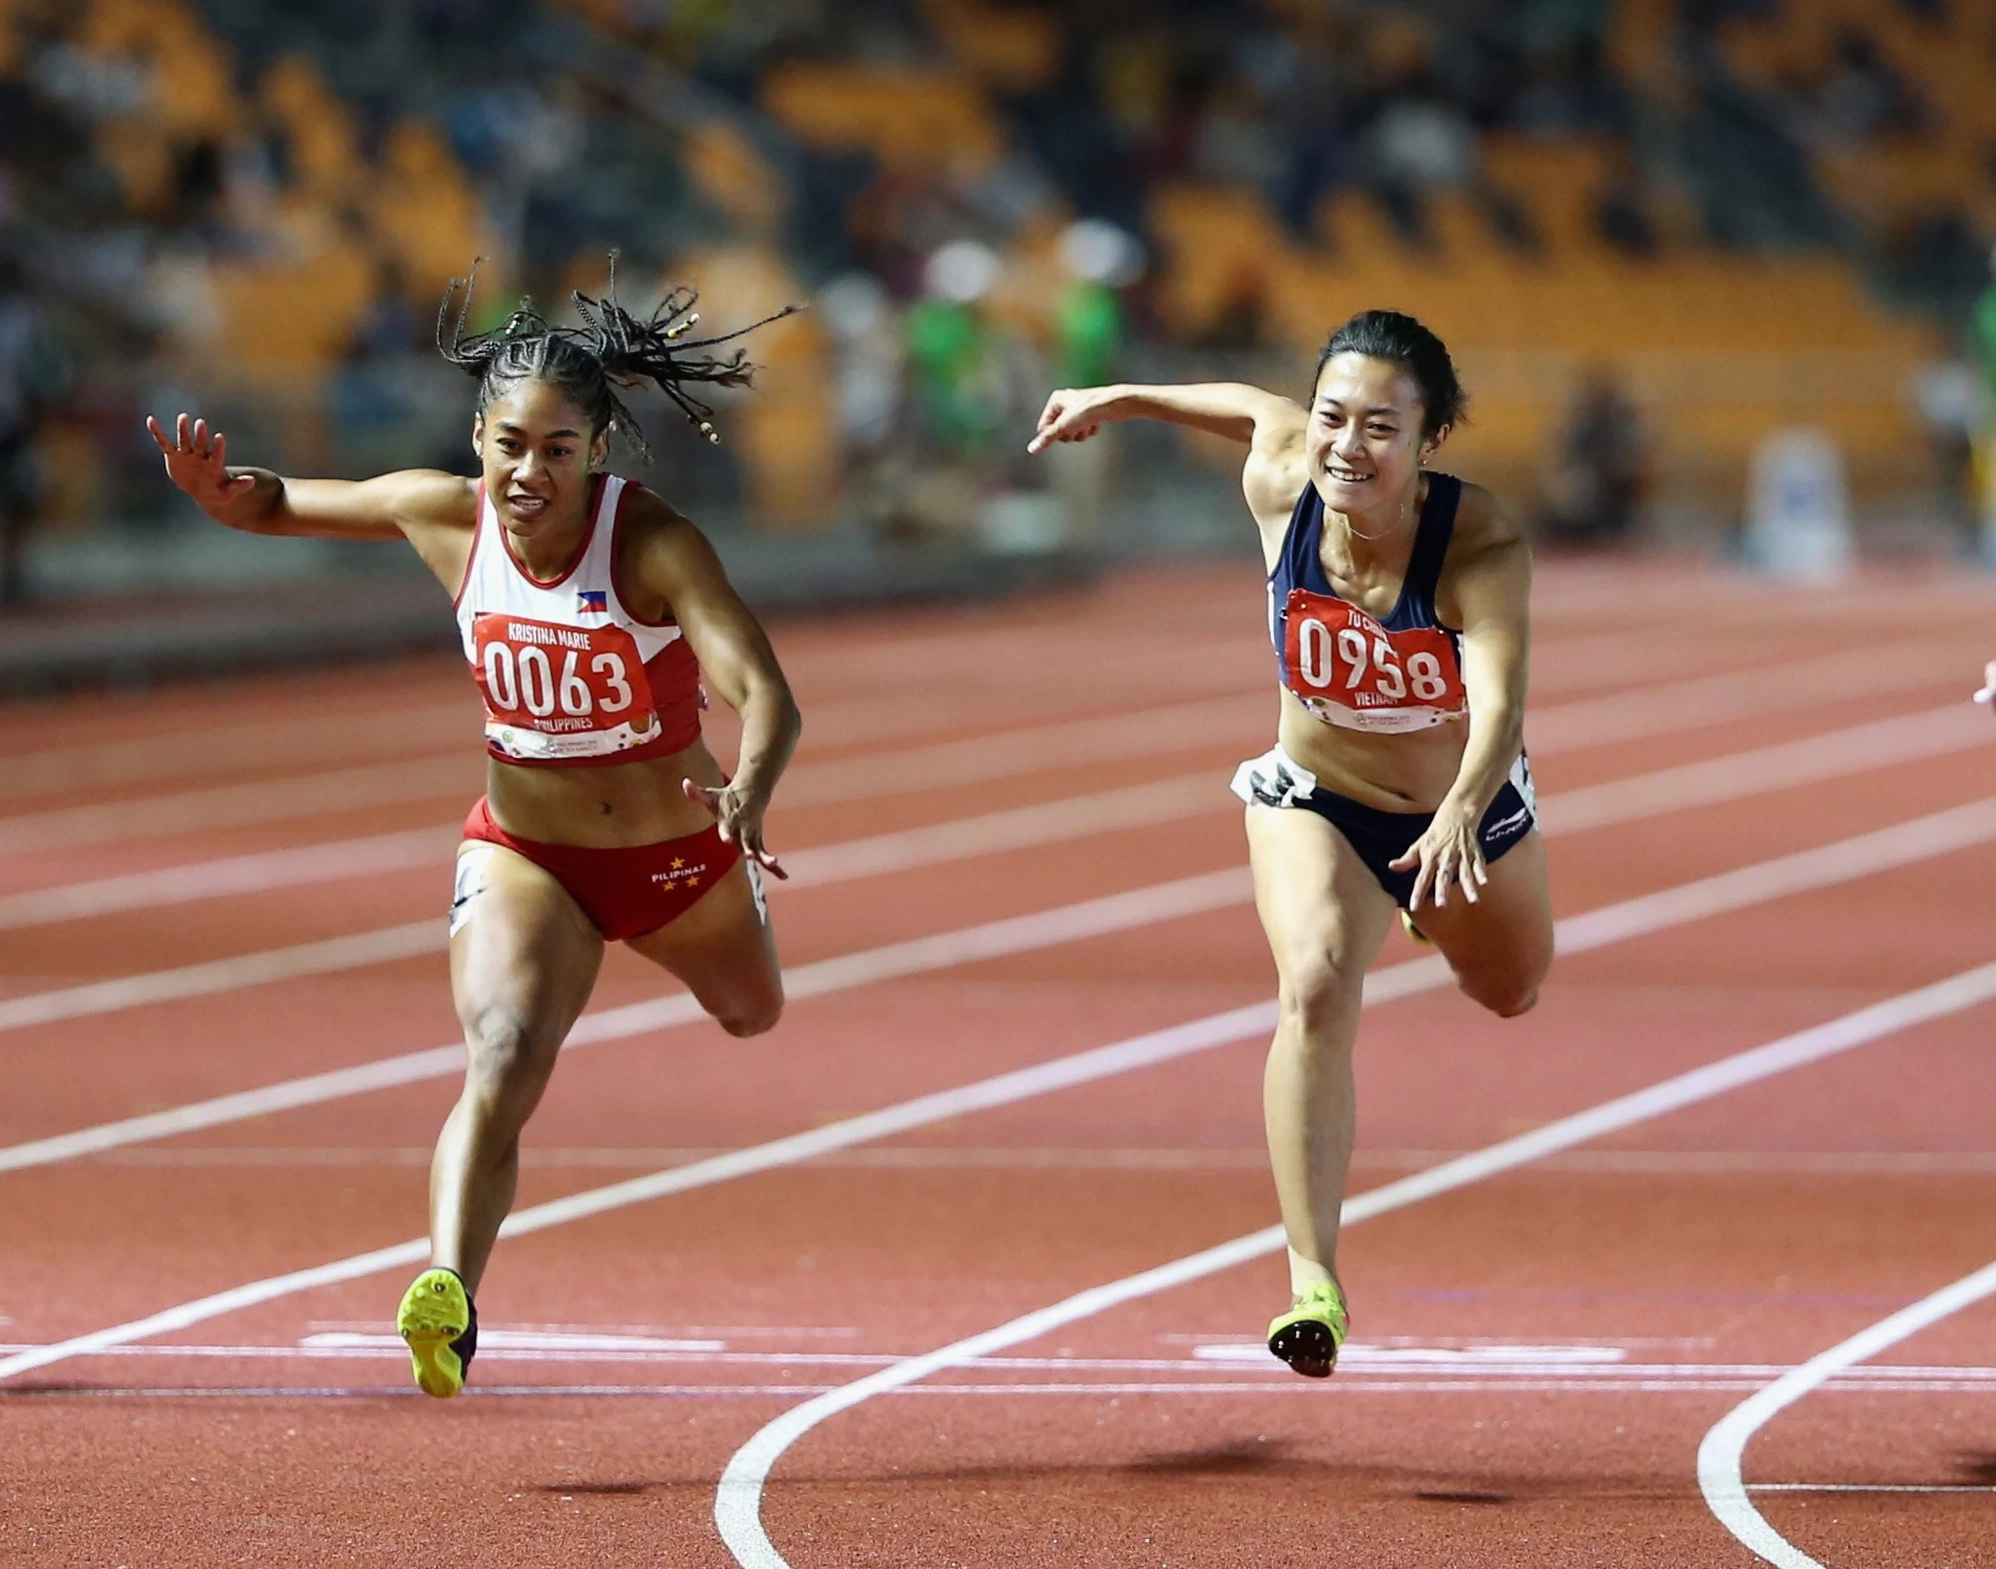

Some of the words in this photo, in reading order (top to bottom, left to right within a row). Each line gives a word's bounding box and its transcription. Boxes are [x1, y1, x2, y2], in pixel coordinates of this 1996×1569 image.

[508, 622, 557, 646] KRISTINA
[557, 629, 592, 651] MARIE
[1299, 618, 1447, 700] 0958
[483, 641, 633, 717] 0063
[533, 716, 593, 732] PHILIPPINES
[651, 863, 707, 883] PILIPINAS
